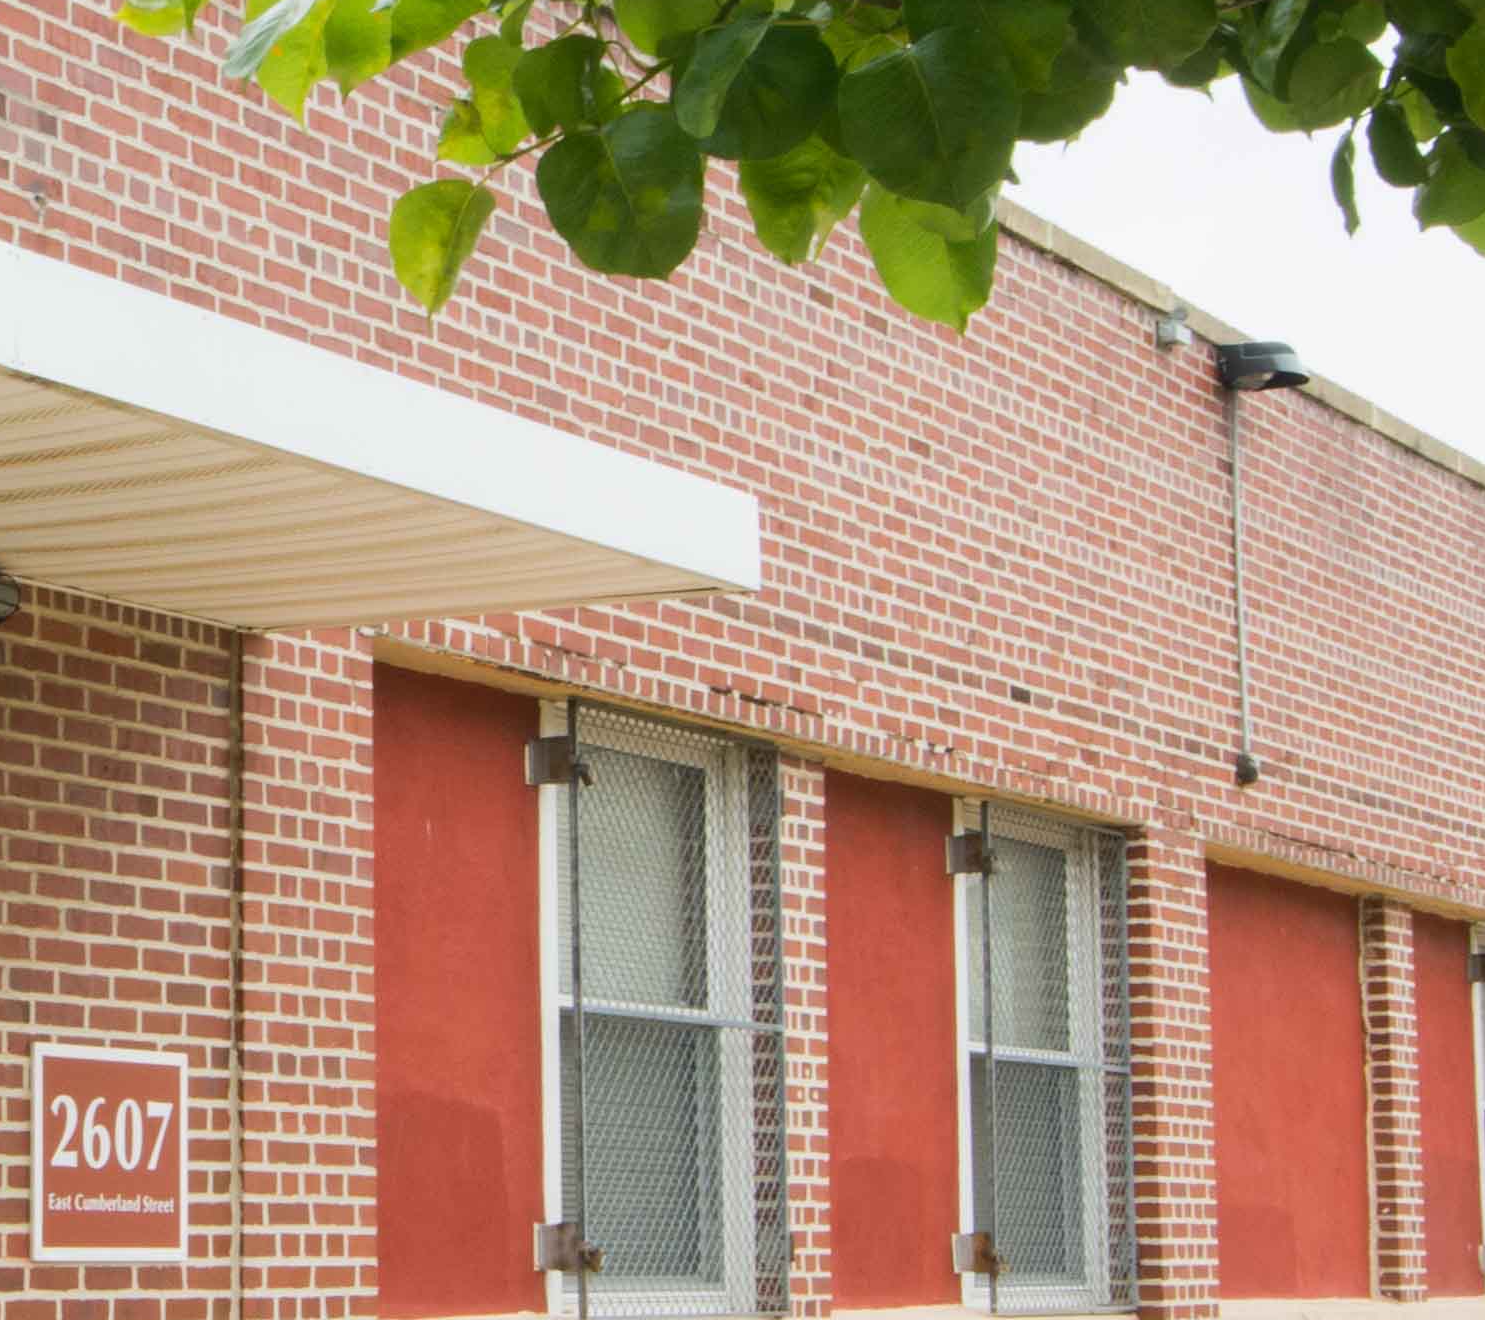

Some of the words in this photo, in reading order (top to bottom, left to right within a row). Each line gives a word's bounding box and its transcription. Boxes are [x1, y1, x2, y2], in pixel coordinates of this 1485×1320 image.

[50, 1094, 174, 1171] 2607
[48, 1192, 71, 1211] East
[74, 1192, 141, 1213] Cumberland
[143, 1194, 175, 1214] Street
